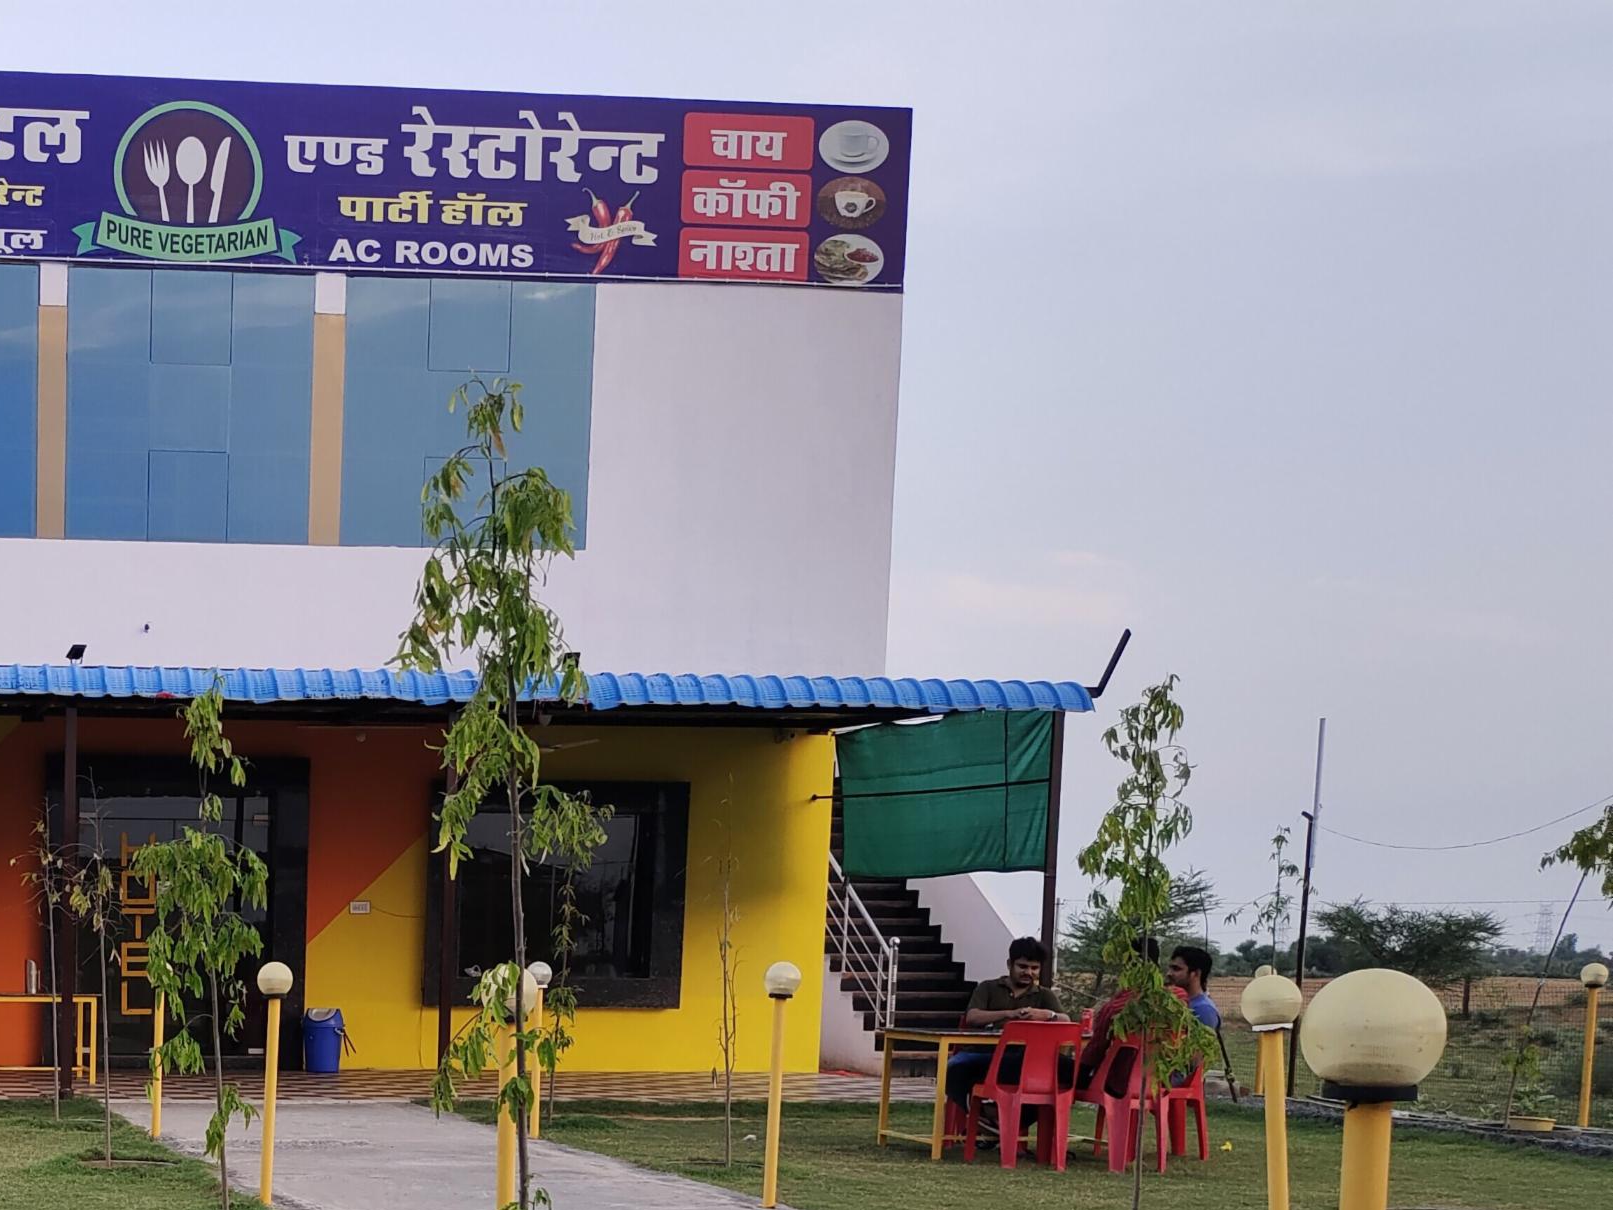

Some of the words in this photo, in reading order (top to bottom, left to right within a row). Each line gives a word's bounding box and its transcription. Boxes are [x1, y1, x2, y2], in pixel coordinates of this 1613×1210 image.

[284, 135, 389, 176] एण्ड
[400, 105, 666, 184] रेस्टोरेन्ट
[710, 129, 788, 161] चाय
[337, 190, 434, 225] पार्टी
[439, 193, 528, 228] हॉल
[691, 178, 802, 221] कॉफी
[106, 219, 153, 250] PURE
[158, 225, 269, 255] VEGETARIAN
[328, 237, 382, 264] AC
[395, 240, 535, 268] ROOMS
[688, 239, 800, 273] नाश्ता
